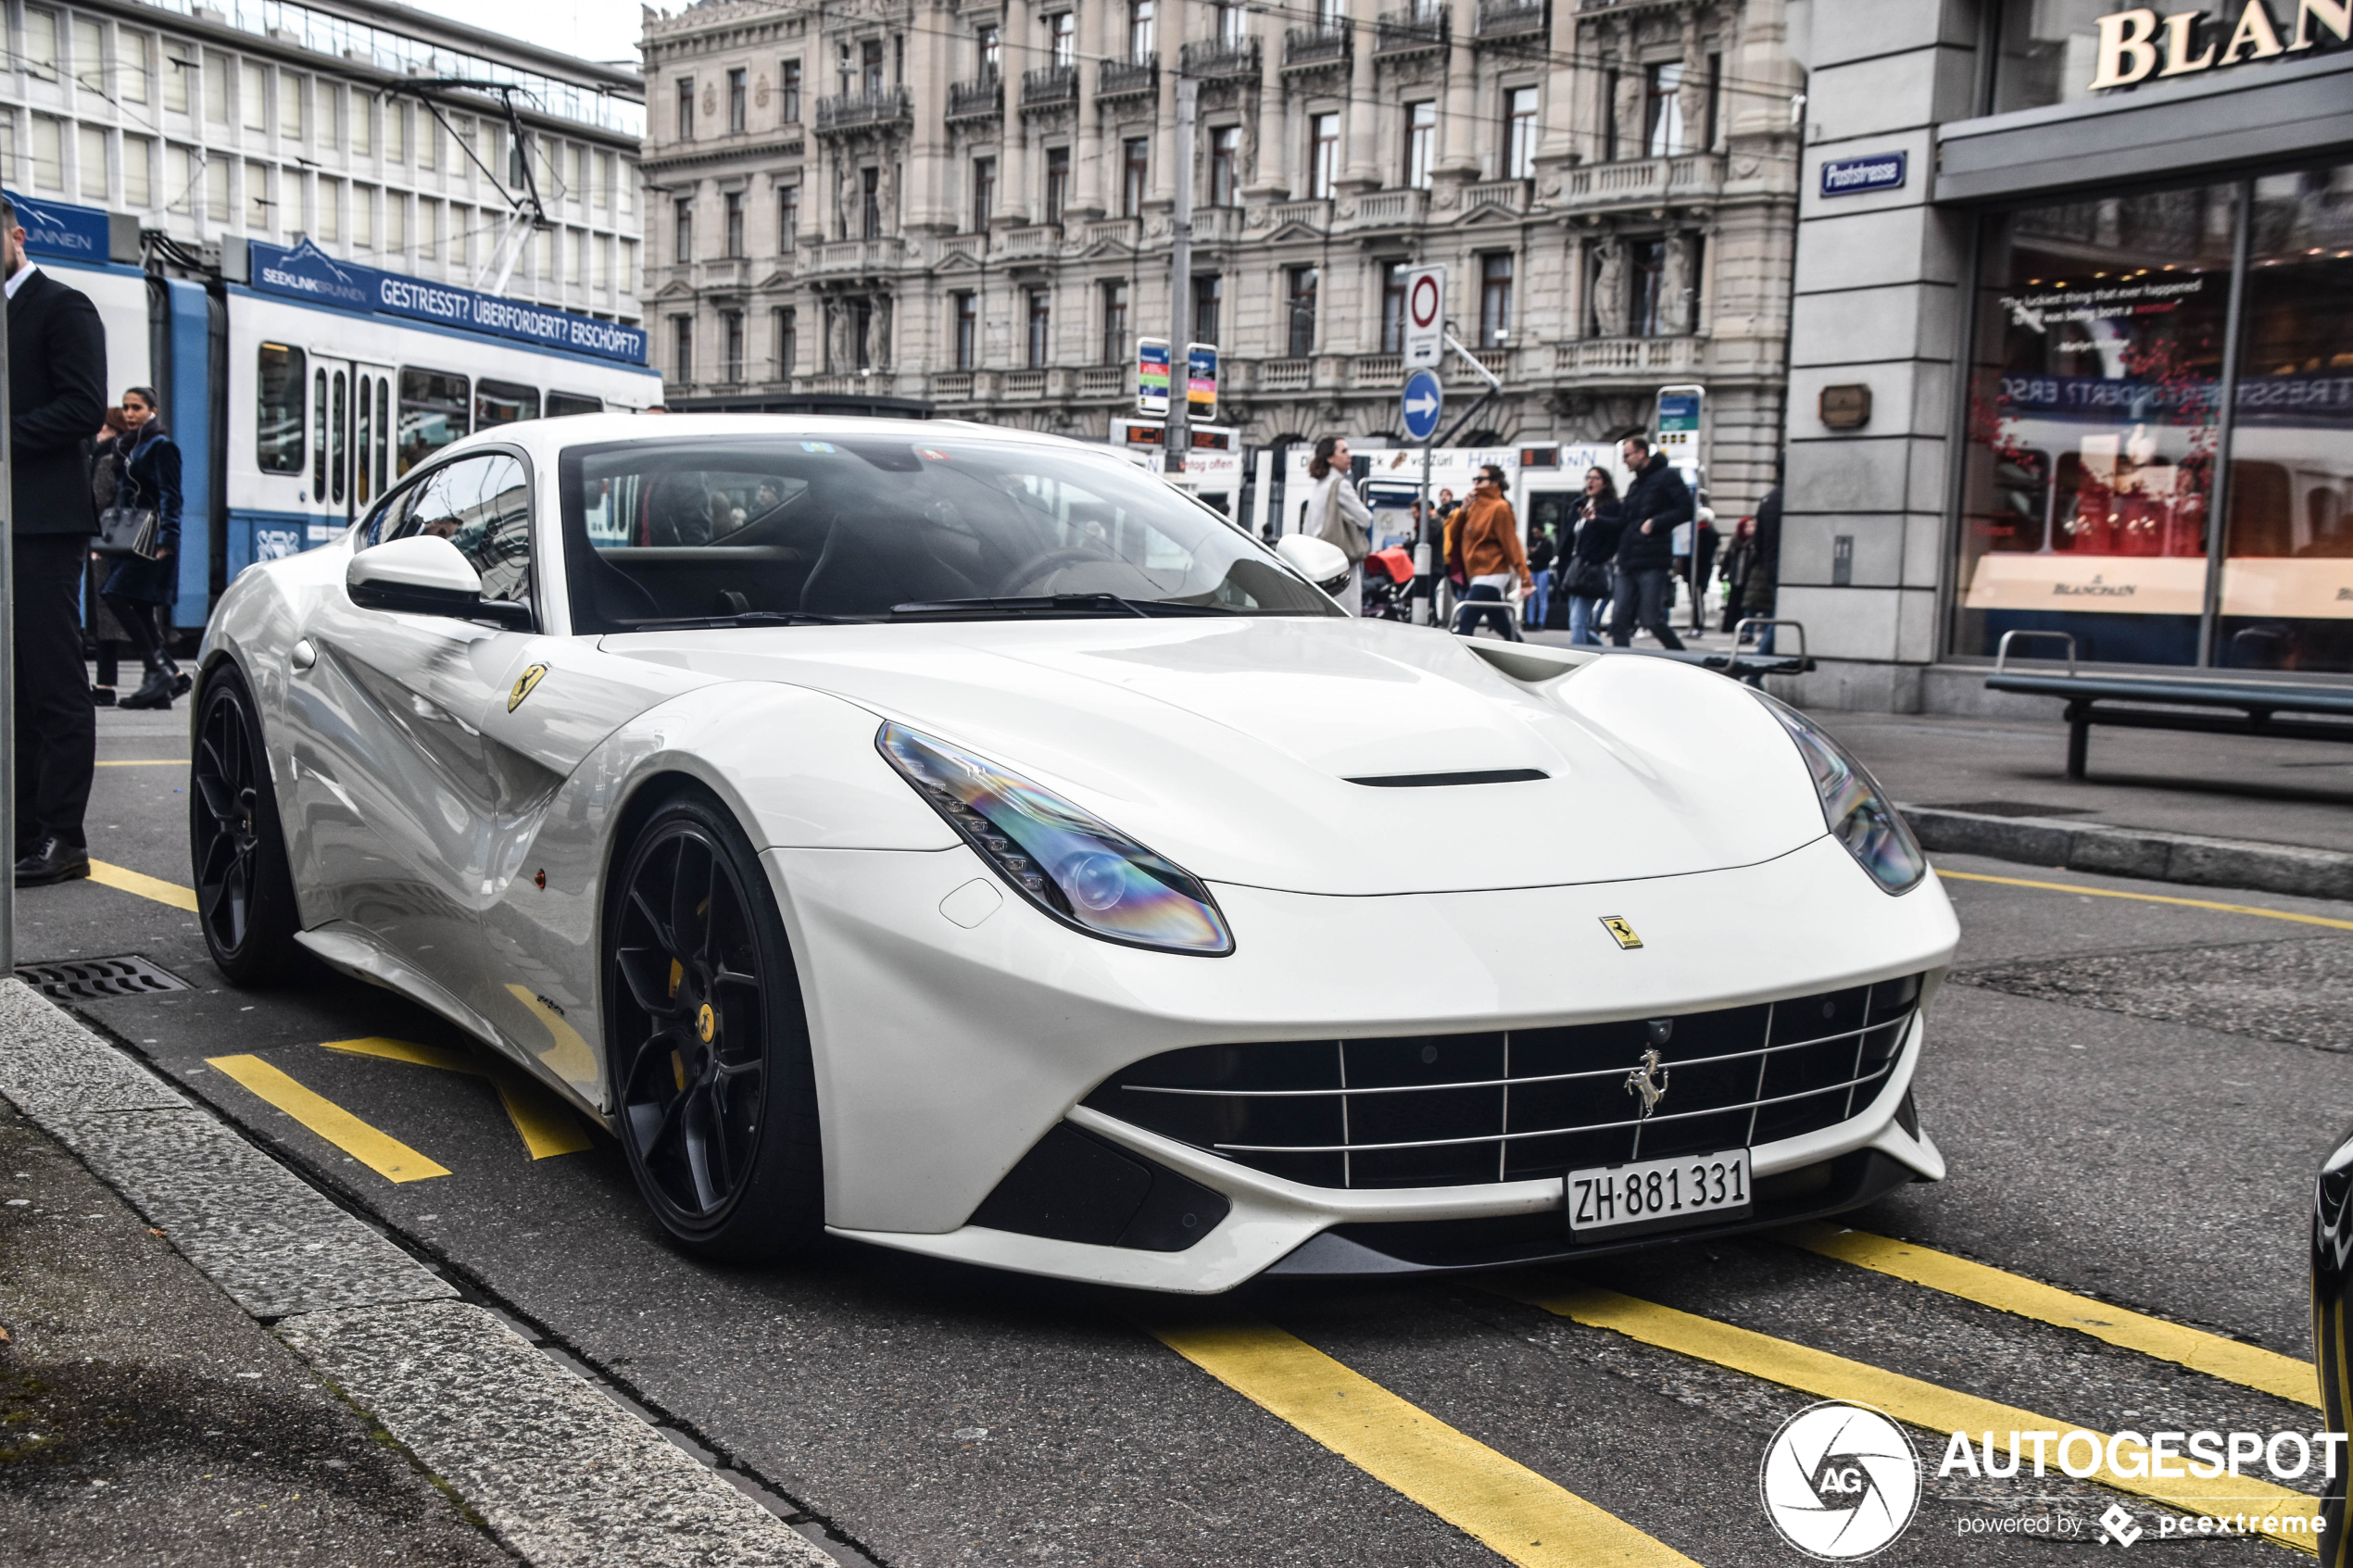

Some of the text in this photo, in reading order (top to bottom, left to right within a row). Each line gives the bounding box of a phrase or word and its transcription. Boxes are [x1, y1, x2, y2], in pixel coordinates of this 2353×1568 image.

[1826, 161, 1897, 189] Poststrasse
[2064, 289, 2093, 304] thing
[2095, 287, 2117, 301] that
[381, 278, 640, 356] GESTRESST? ÜBERFORDERT? ERSCHÖPFT?
